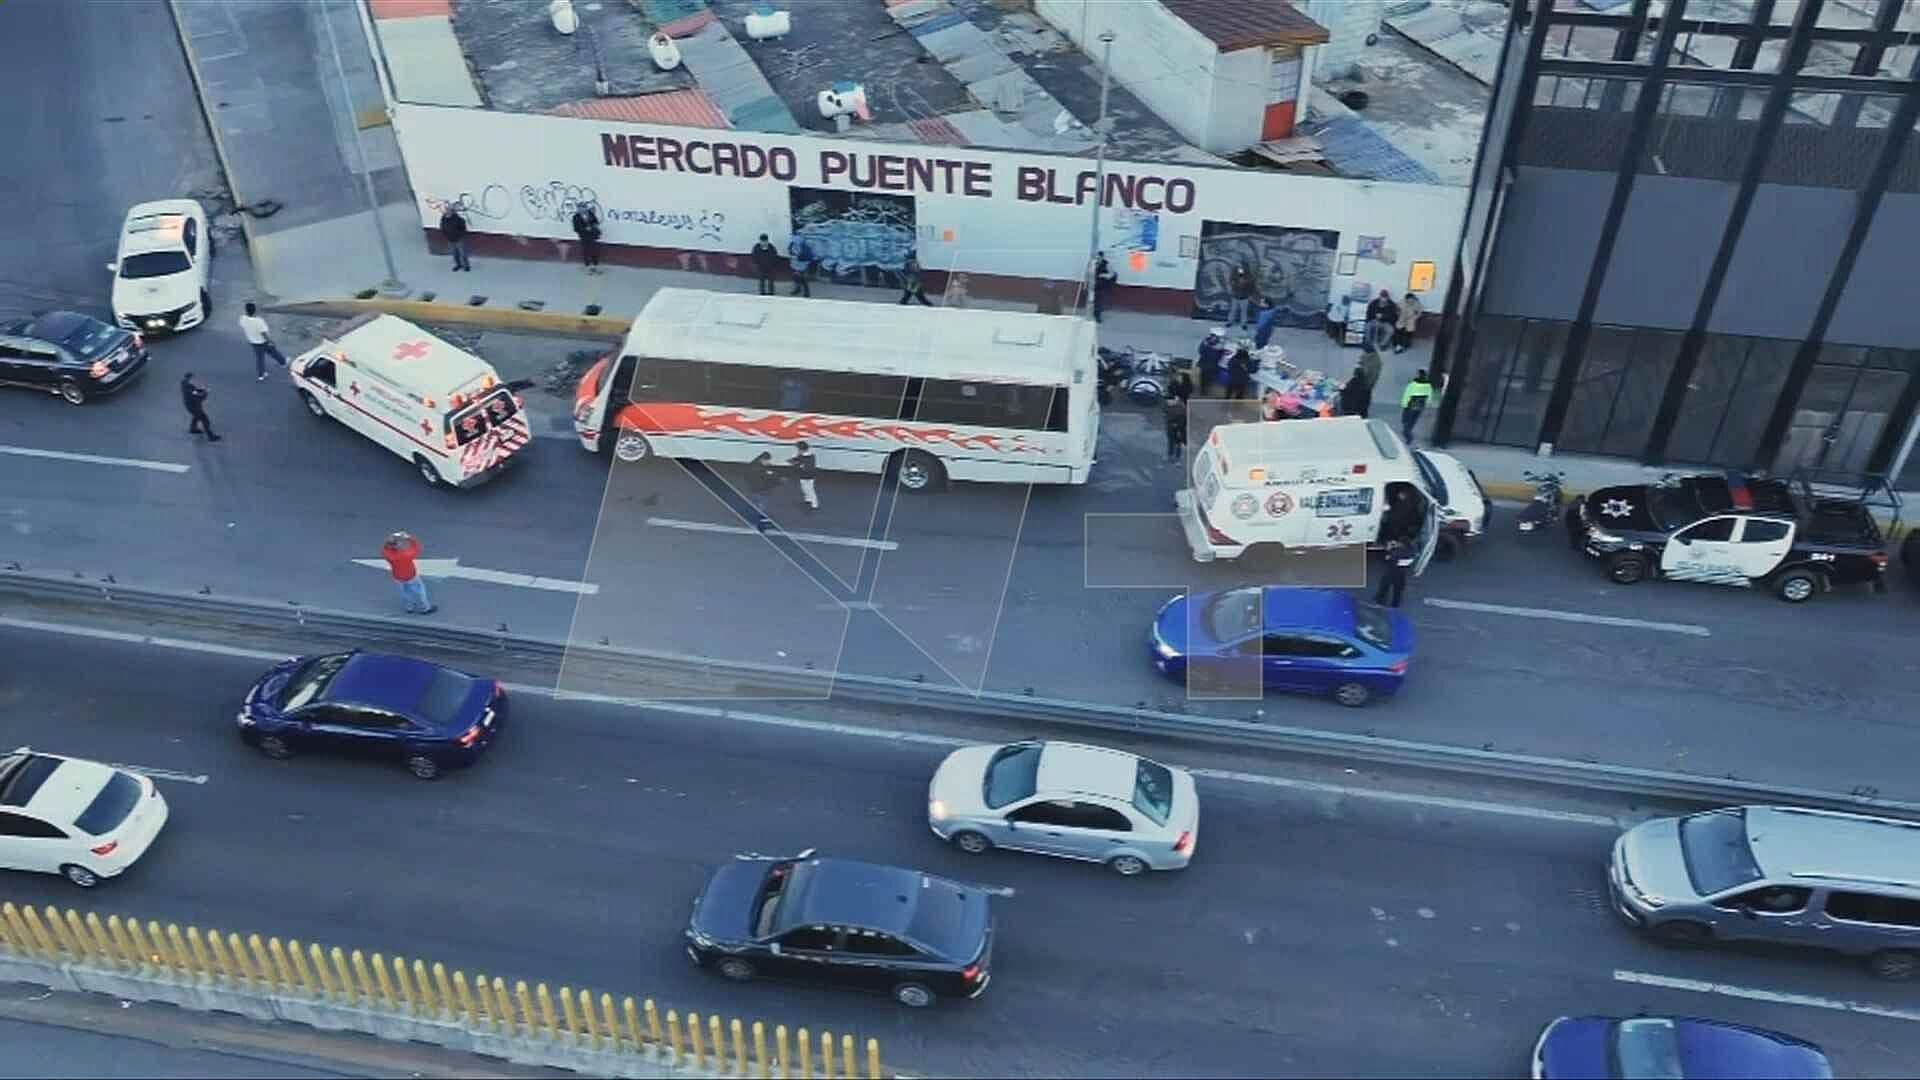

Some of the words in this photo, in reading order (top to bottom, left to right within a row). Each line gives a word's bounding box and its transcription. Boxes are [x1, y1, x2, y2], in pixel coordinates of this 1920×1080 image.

[600, 132, 798, 182] MERCADO
[819, 150, 993, 198] PUENTE
[1017, 165, 1196, 214] BLANCO
